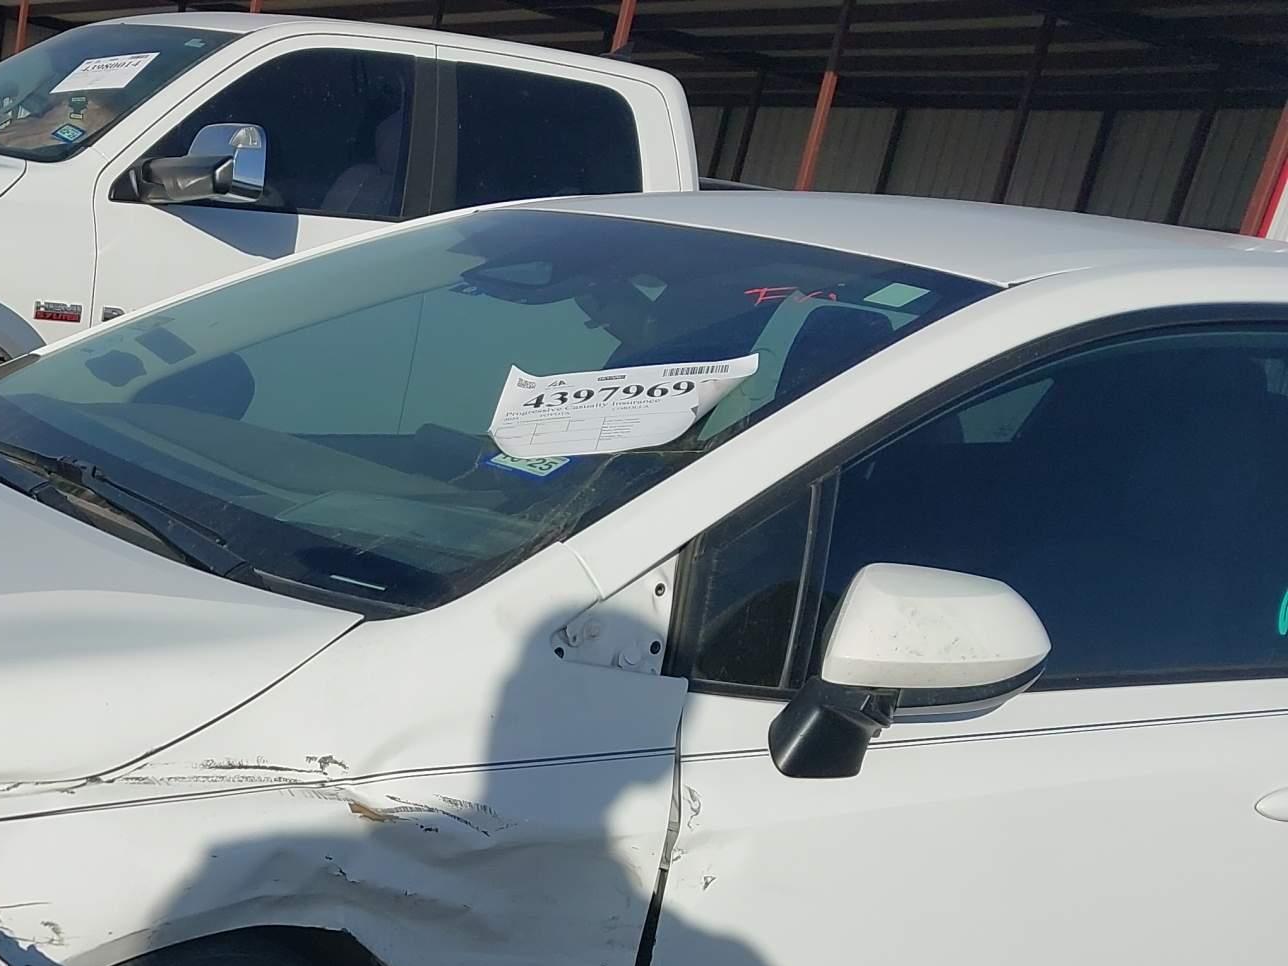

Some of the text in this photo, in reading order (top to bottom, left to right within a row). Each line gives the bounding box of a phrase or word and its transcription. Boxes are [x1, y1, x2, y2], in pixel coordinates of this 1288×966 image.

[35, 301, 82, 313] HEMI
[523, 378, 719, 409] 4397969
[611, 398, 661, 407] Insurance
